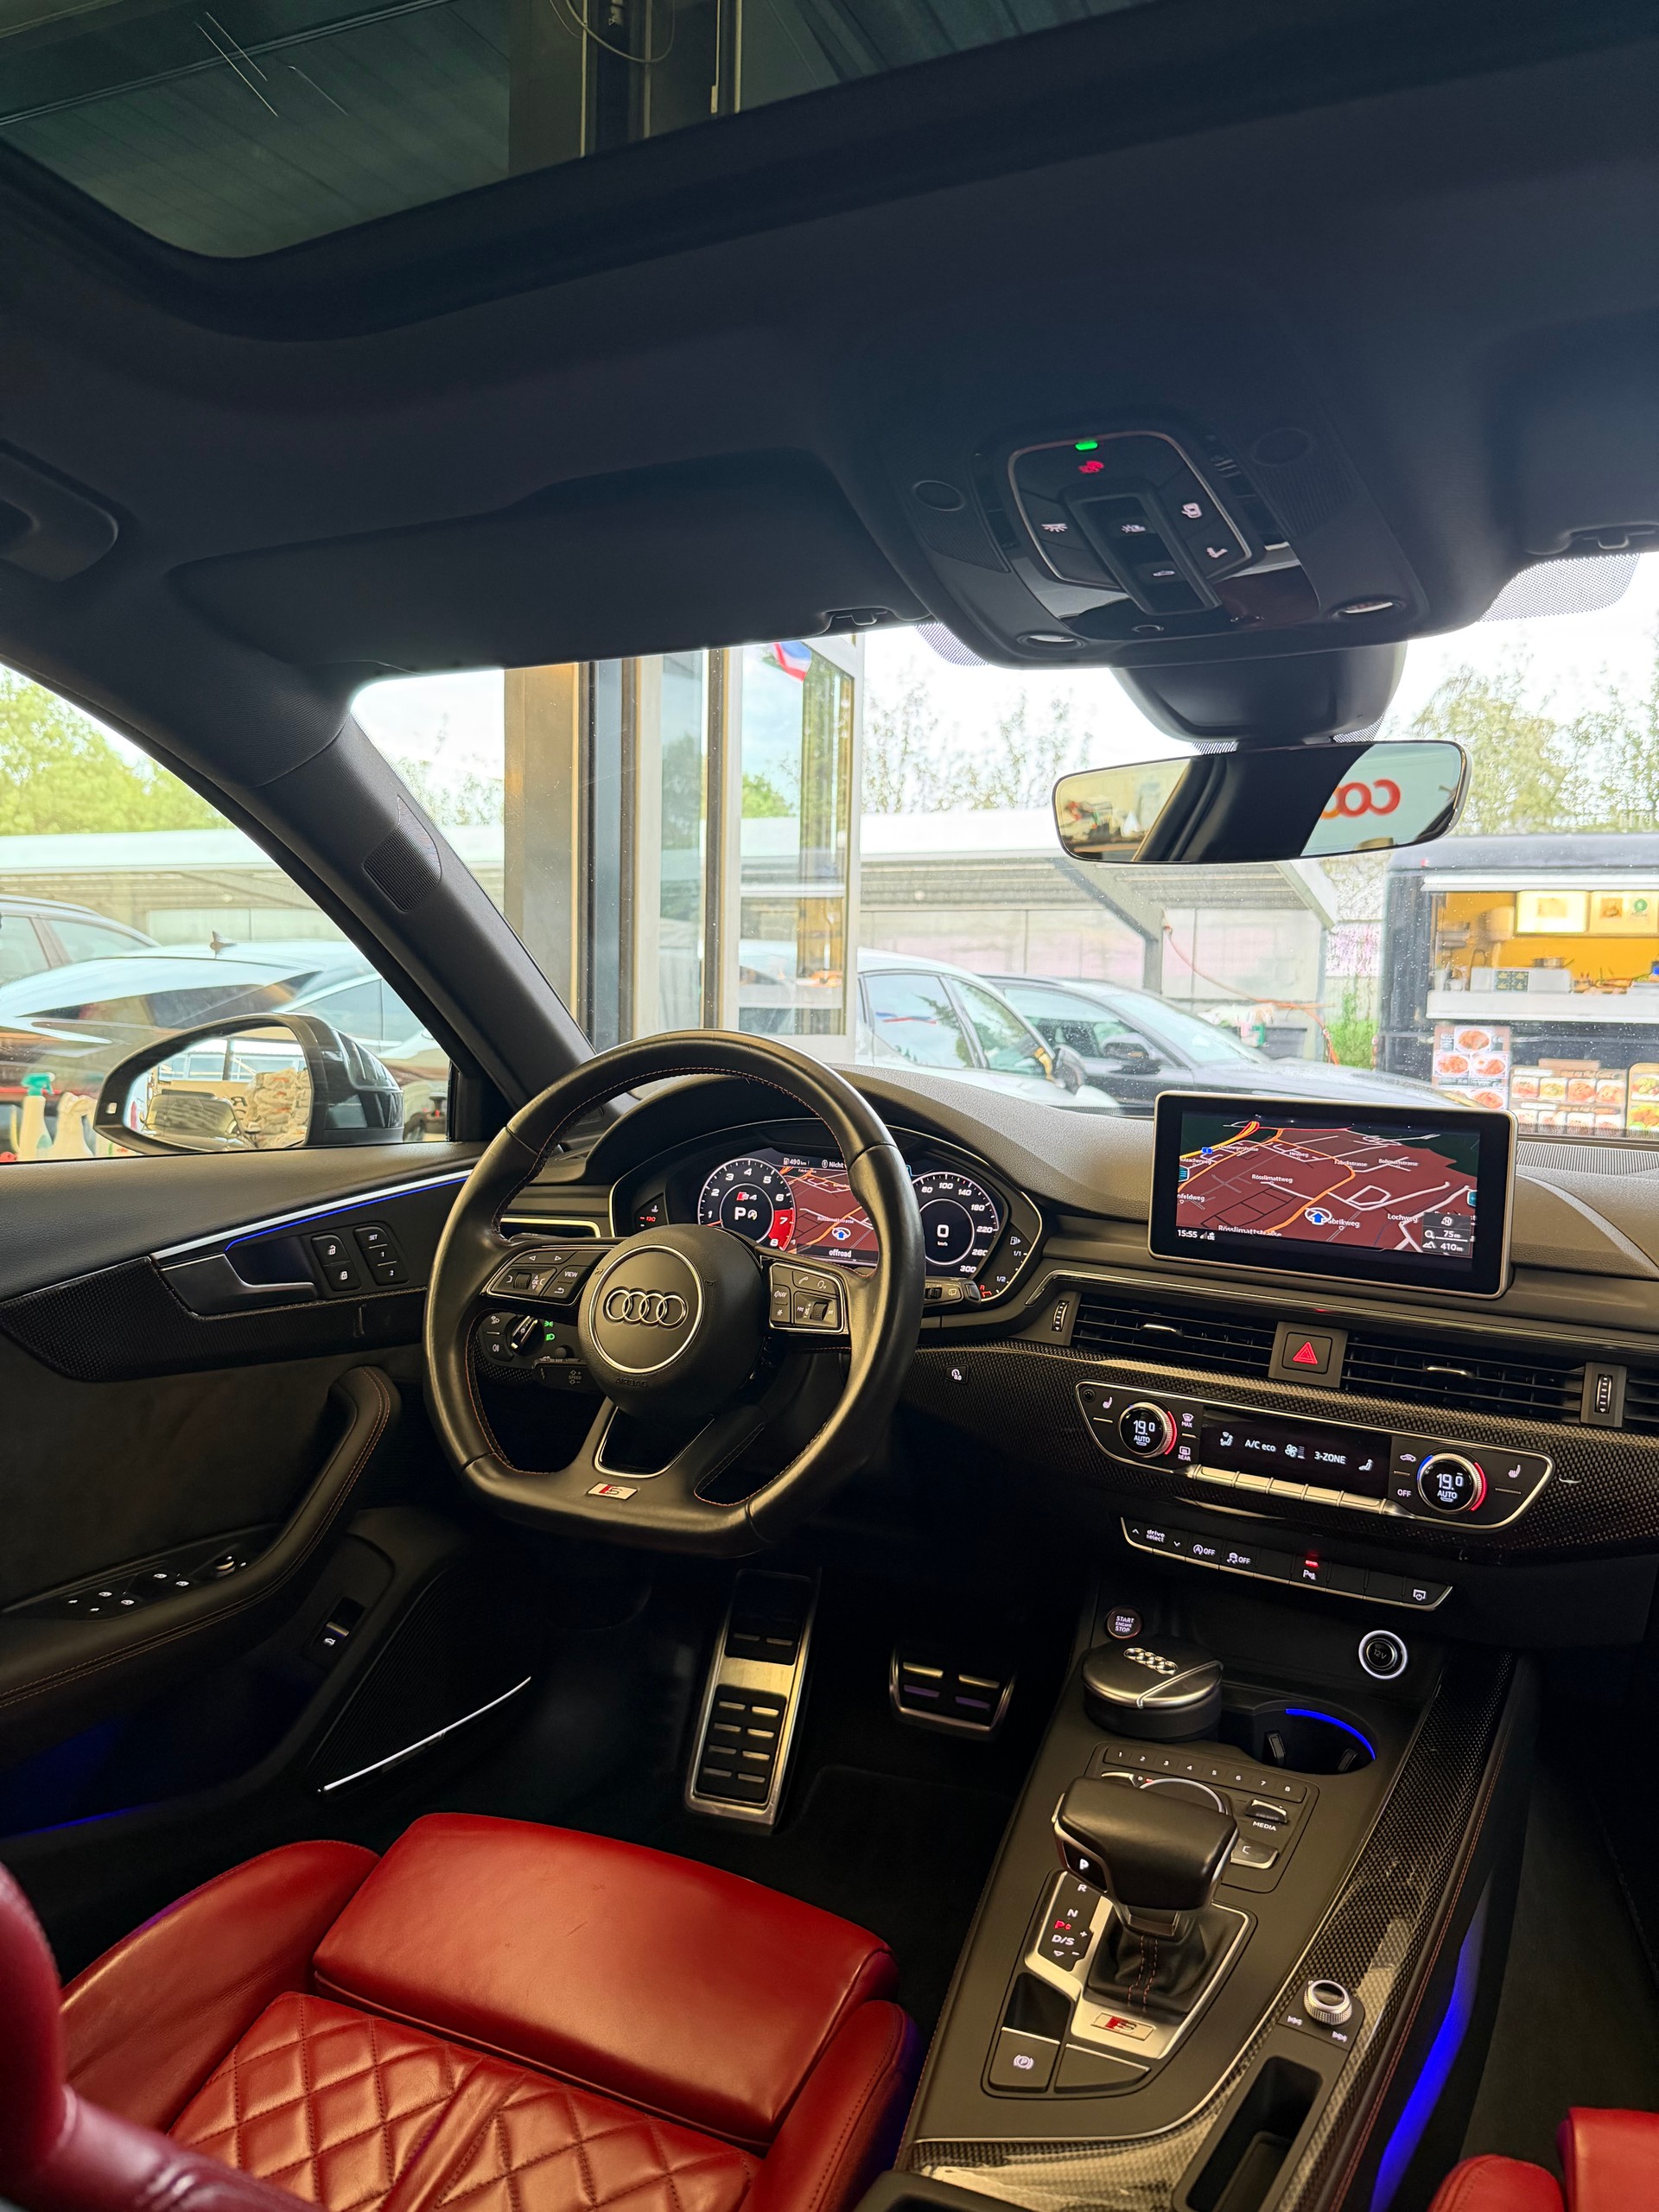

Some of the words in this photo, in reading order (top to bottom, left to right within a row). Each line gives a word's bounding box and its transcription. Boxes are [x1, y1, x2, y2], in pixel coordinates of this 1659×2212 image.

[725, 1173, 734, 1181] 3
[763, 1175, 772, 1184] 5
[710, 1188, 721, 1197] 2
[775, 1193, 785, 1202] 6
[708, 1210, 713, 1218] 1
[734, 1206, 747, 1221] P
[1387, 1213, 1419, 1224] Lochweg
[937, 1224, 950, 1238] 0
[976, 1225, 993, 1234] 220
[1177, 1229, 1198, 1239] 15:55
[829, 1249, 852, 1258] offroad
[971, 1248, 988, 1256] 260
[959, 1265, 977, 1274] 300
[564, 1270, 579, 1279] VIEW
[615, 1377, 649, 1388] AIRBAG
[1133, 1420, 1156, 1436] 19.0
[1133, 1435, 1151, 1444] AUTO
[1244, 1439, 1261, 1449] A/C
[1261, 1443, 1277, 1452] eco
[1178, 1453, 1192, 1462] REAR
[1313, 1451, 1347, 1465] 3-ZONE
[1436, 1472, 1464, 1491] 19.0
[1396, 1488, 1412, 1497] OFF
[1437, 1490, 1458, 1499] AUTO
[1145, 1533, 1165, 1542] select
[1146, 1529, 1166, 1538] drive
[1203, 1548, 1216, 1556] OFF
[1237, 1556, 1251, 1565] OFF
[1116, 1615, 1135, 1624] START
[1252, 1821, 1277, 1831] MEDIA
[1079, 1858, 1090, 1870] P
[1077, 1884, 1088, 1892] R
[1067, 1908, 1078, 1917] N
[1051, 1934, 1076, 1946] D/S
